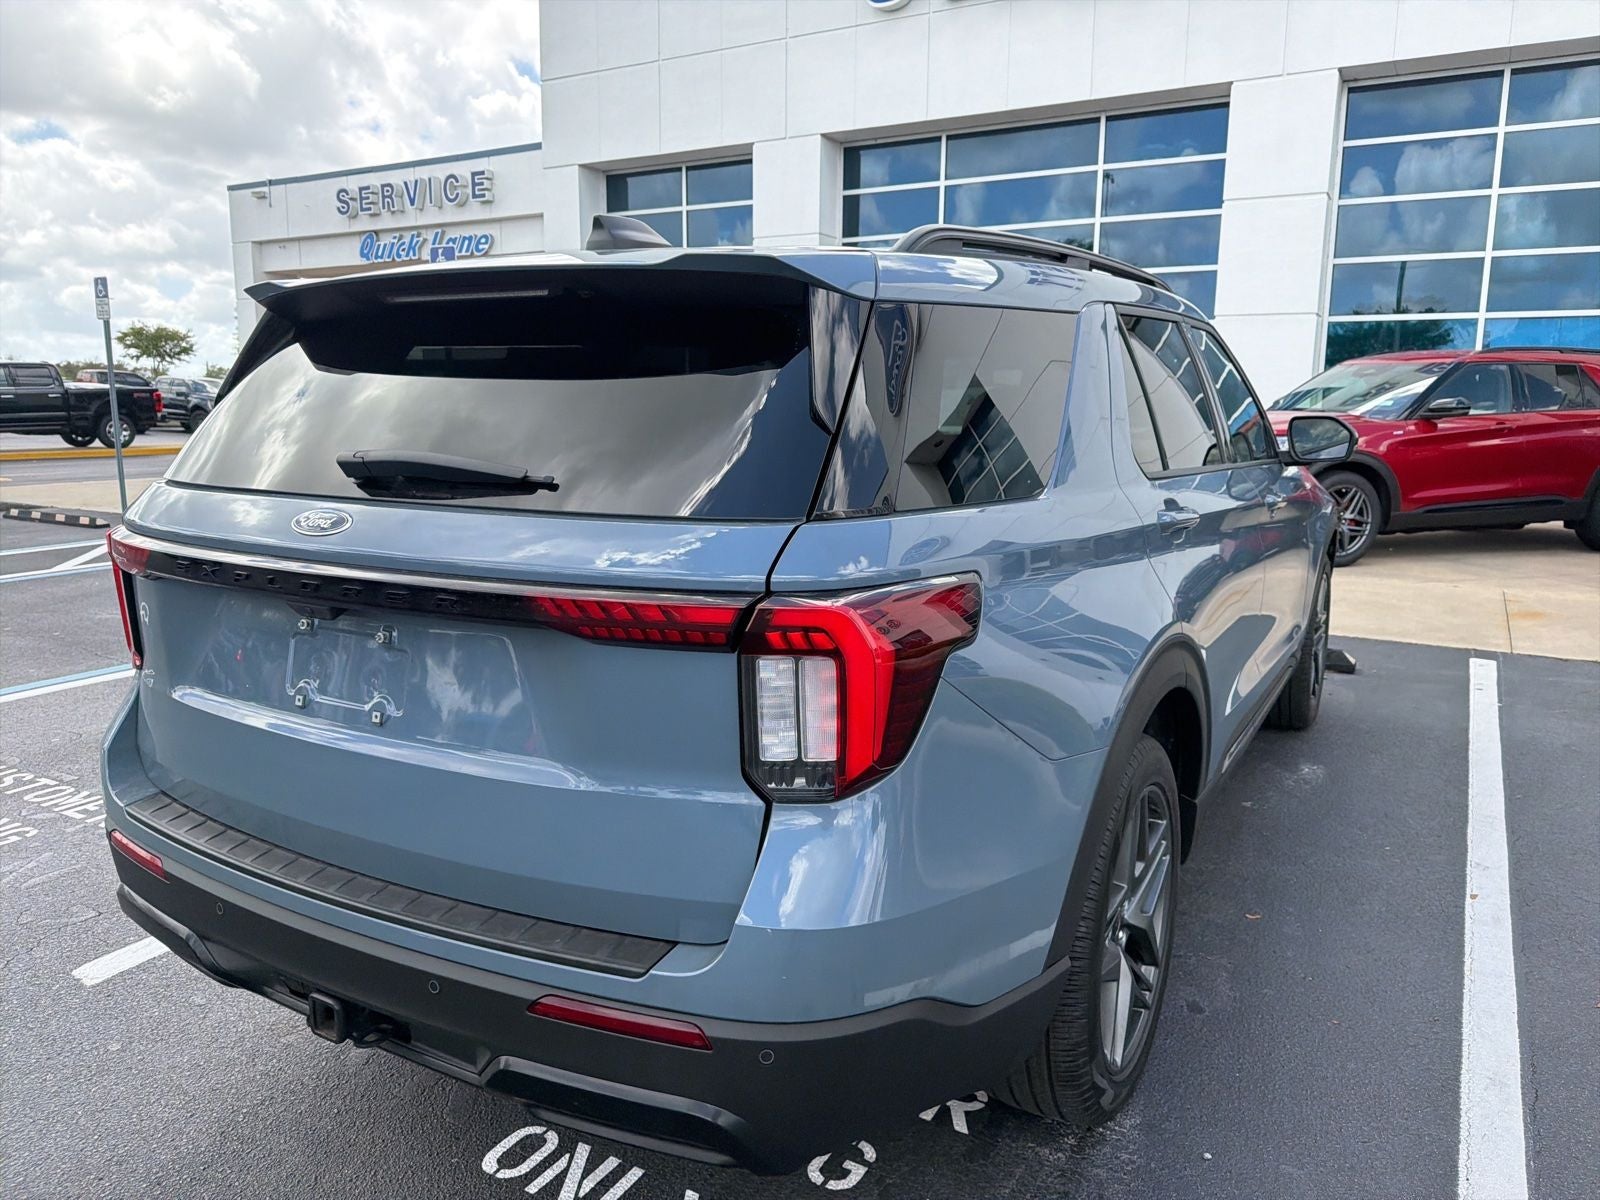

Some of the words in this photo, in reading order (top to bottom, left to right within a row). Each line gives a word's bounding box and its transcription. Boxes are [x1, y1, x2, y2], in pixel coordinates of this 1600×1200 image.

[336, 169, 489, 217] SERVICE
[359, 231, 423, 263] Quick
[175, 560, 457, 609] EXPLORER
